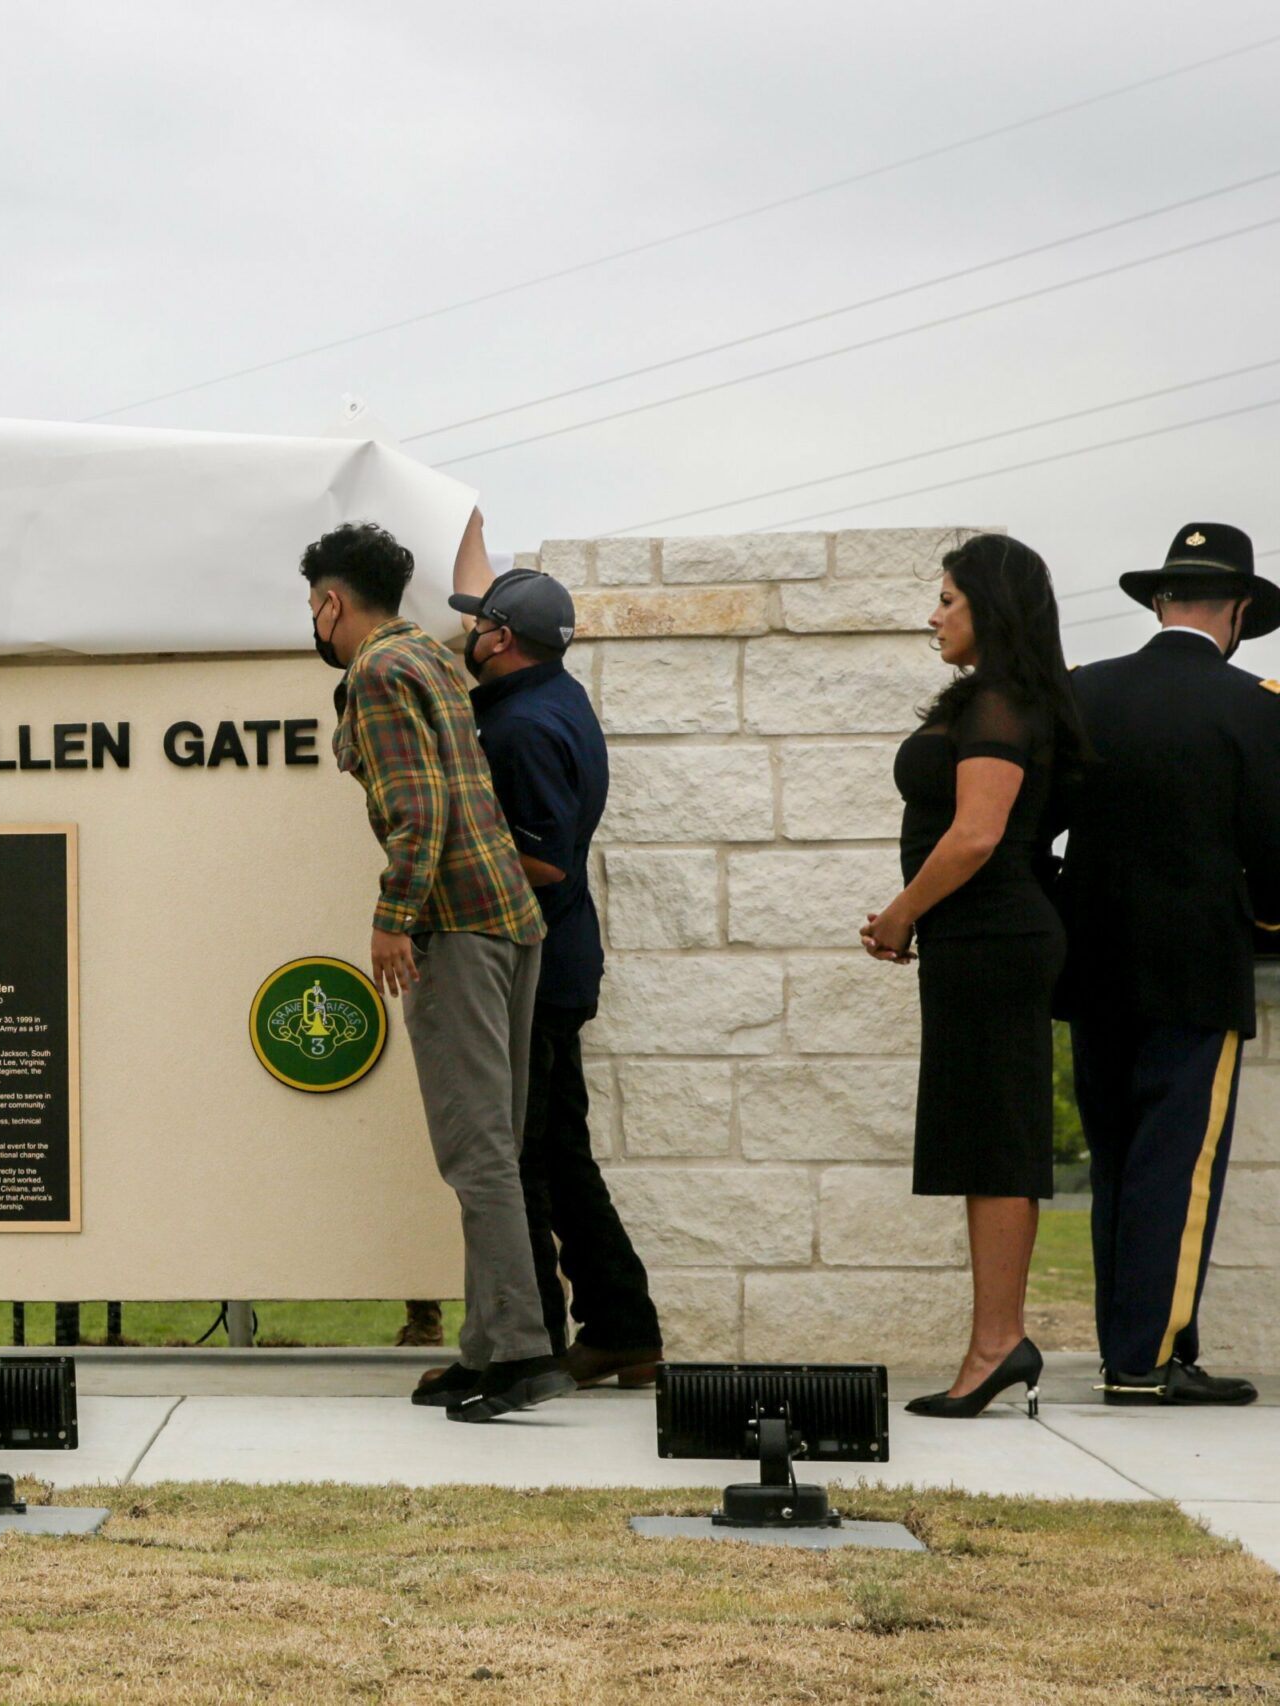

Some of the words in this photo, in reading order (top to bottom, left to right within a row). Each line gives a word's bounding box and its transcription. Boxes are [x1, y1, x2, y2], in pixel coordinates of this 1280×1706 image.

[163, 718, 319, 768] GATE
[272, 1002, 303, 1026] BRAVE
[326, 1002, 362, 1026] RIFLES
[17, 1015, 33, 1024] 1999
[0, 1024, 17, 1034] Army
[35, 1024, 47, 1032] 91F
[311, 1038, 326, 1056] 3
[32, 1049, 51, 1057] South
[31, 1067, 41, 1075] the
[12, 1117, 41, 1125] technical
[7, 1142, 25, 1150] event
[27, 1142, 36, 1150] for
[38, 1142, 48, 1150] the
[26, 1167, 36, 1175] the
[3, 1176, 15, 1184] and
[32, 1185, 44, 1193] and
[6, 1194, 18, 1202] that
